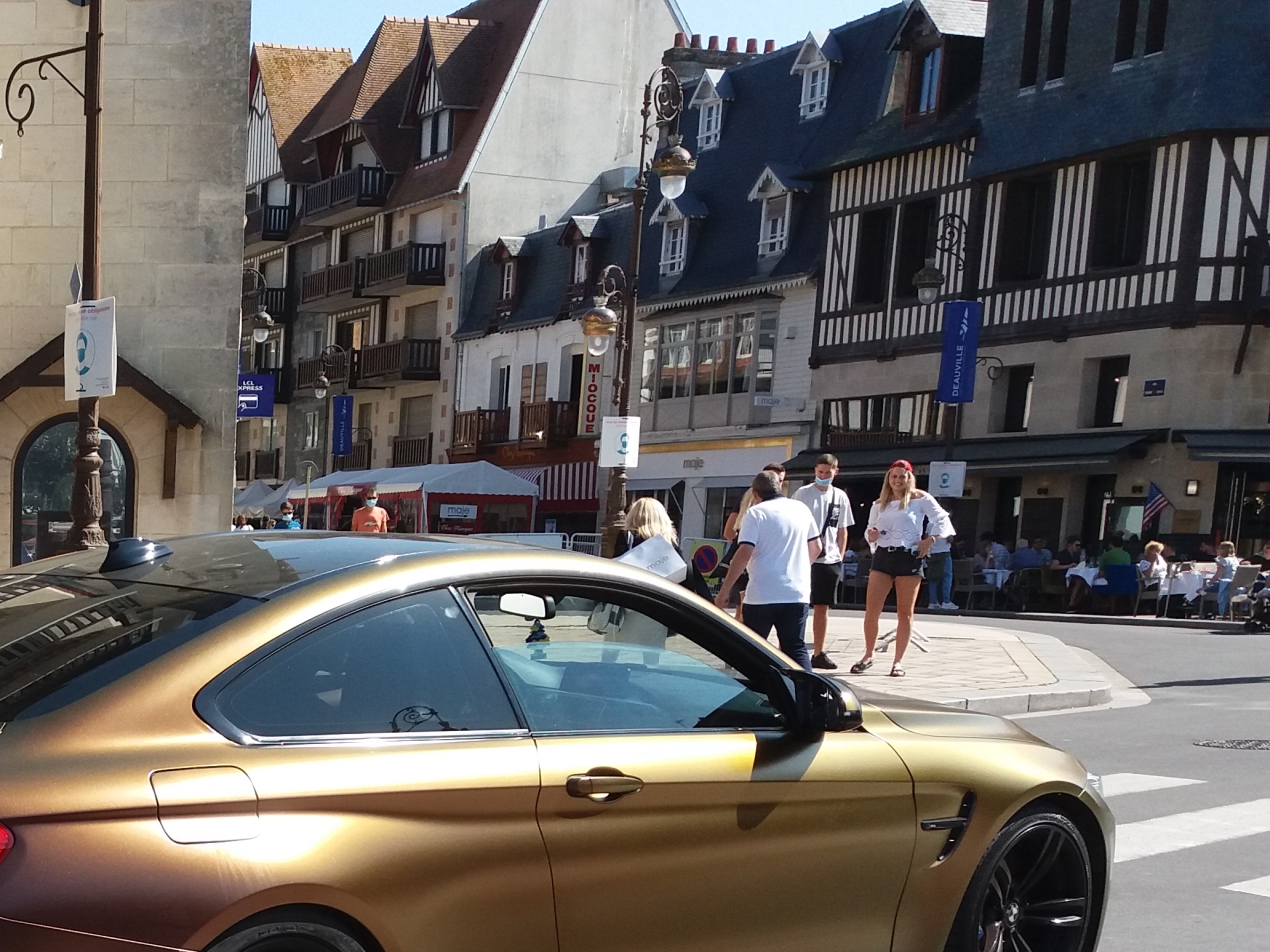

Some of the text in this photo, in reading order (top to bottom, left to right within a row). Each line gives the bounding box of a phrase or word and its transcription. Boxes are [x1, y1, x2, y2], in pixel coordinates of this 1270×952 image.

[952, 345, 964, 396] DEAUVILLE
[761, 396, 781, 405] maje
[683, 457, 704, 470] maje
[448, 506, 470, 516] maje
[647, 555, 669, 570] maje
